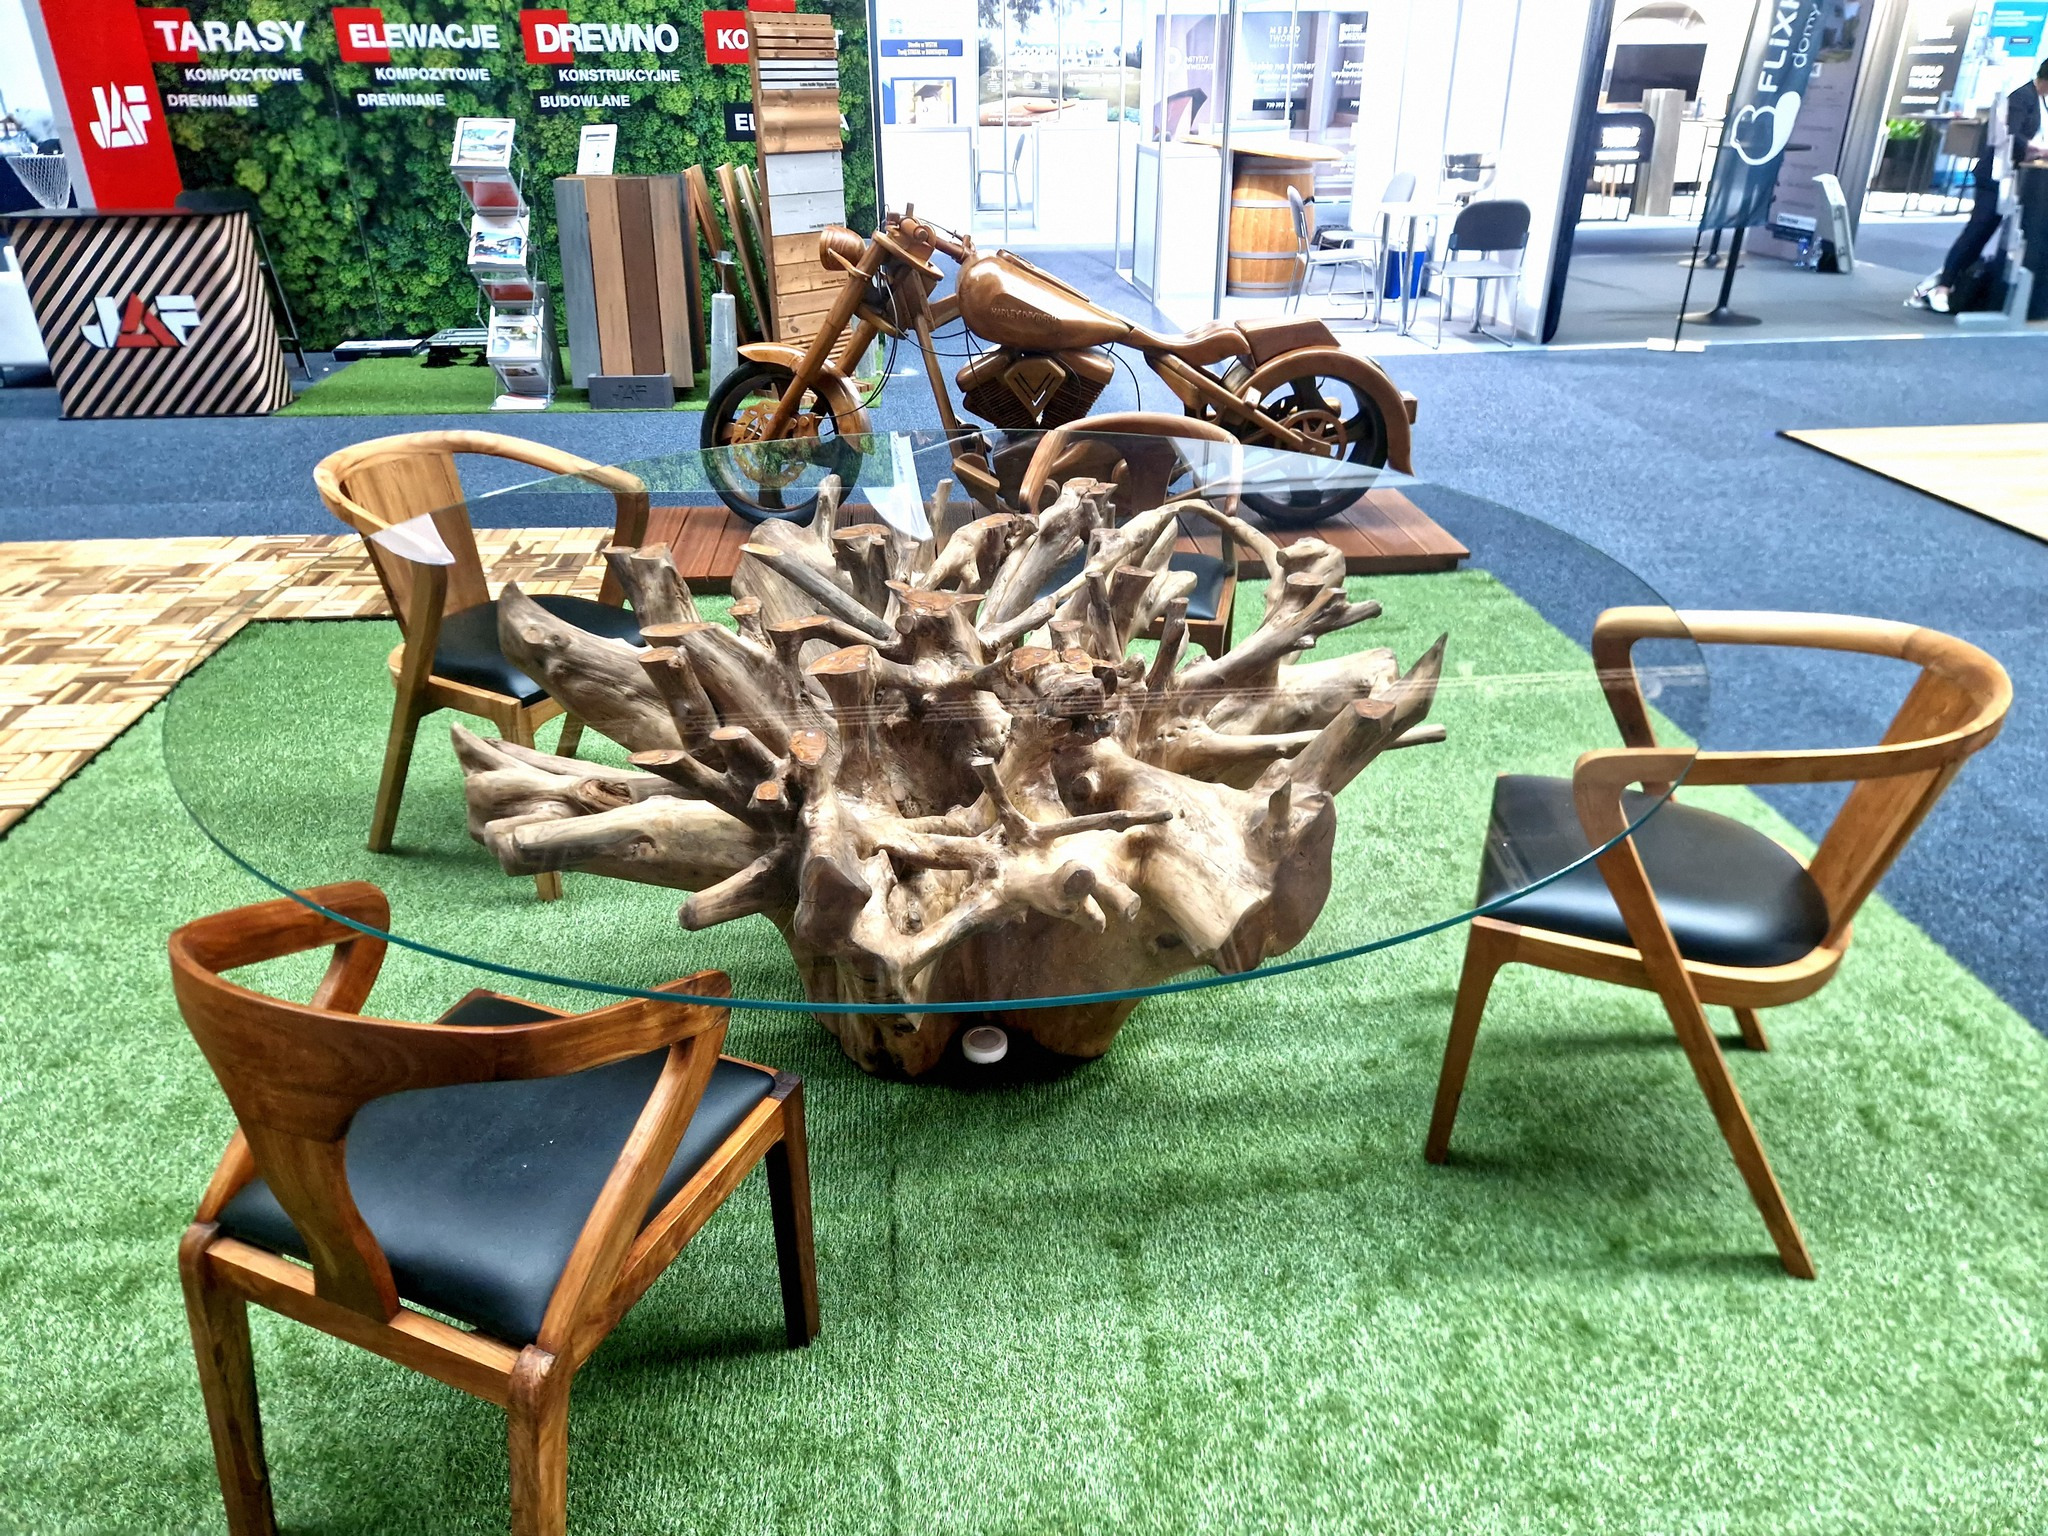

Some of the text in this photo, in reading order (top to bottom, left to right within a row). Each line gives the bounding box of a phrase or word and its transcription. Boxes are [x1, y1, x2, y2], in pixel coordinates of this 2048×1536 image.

[153, 20, 306, 53] TARASY
[348, 23, 500, 50] ELEWACJE
[534, 23, 679, 53] DREWNO
[185, 67, 304, 82] KOMPOZYTOWE
[375, 66, 490, 81] KOMPOZYTOWE
[558, 68, 681, 83] KONSTRUKCYJNE
[167, 93, 259, 109] DREWNIANE
[356, 93, 446, 108] DREWNIANE
[539, 94, 632, 109] BUDOWLANE
[89, 82, 152, 149] JAF
[80, 292, 200, 349] JAF
